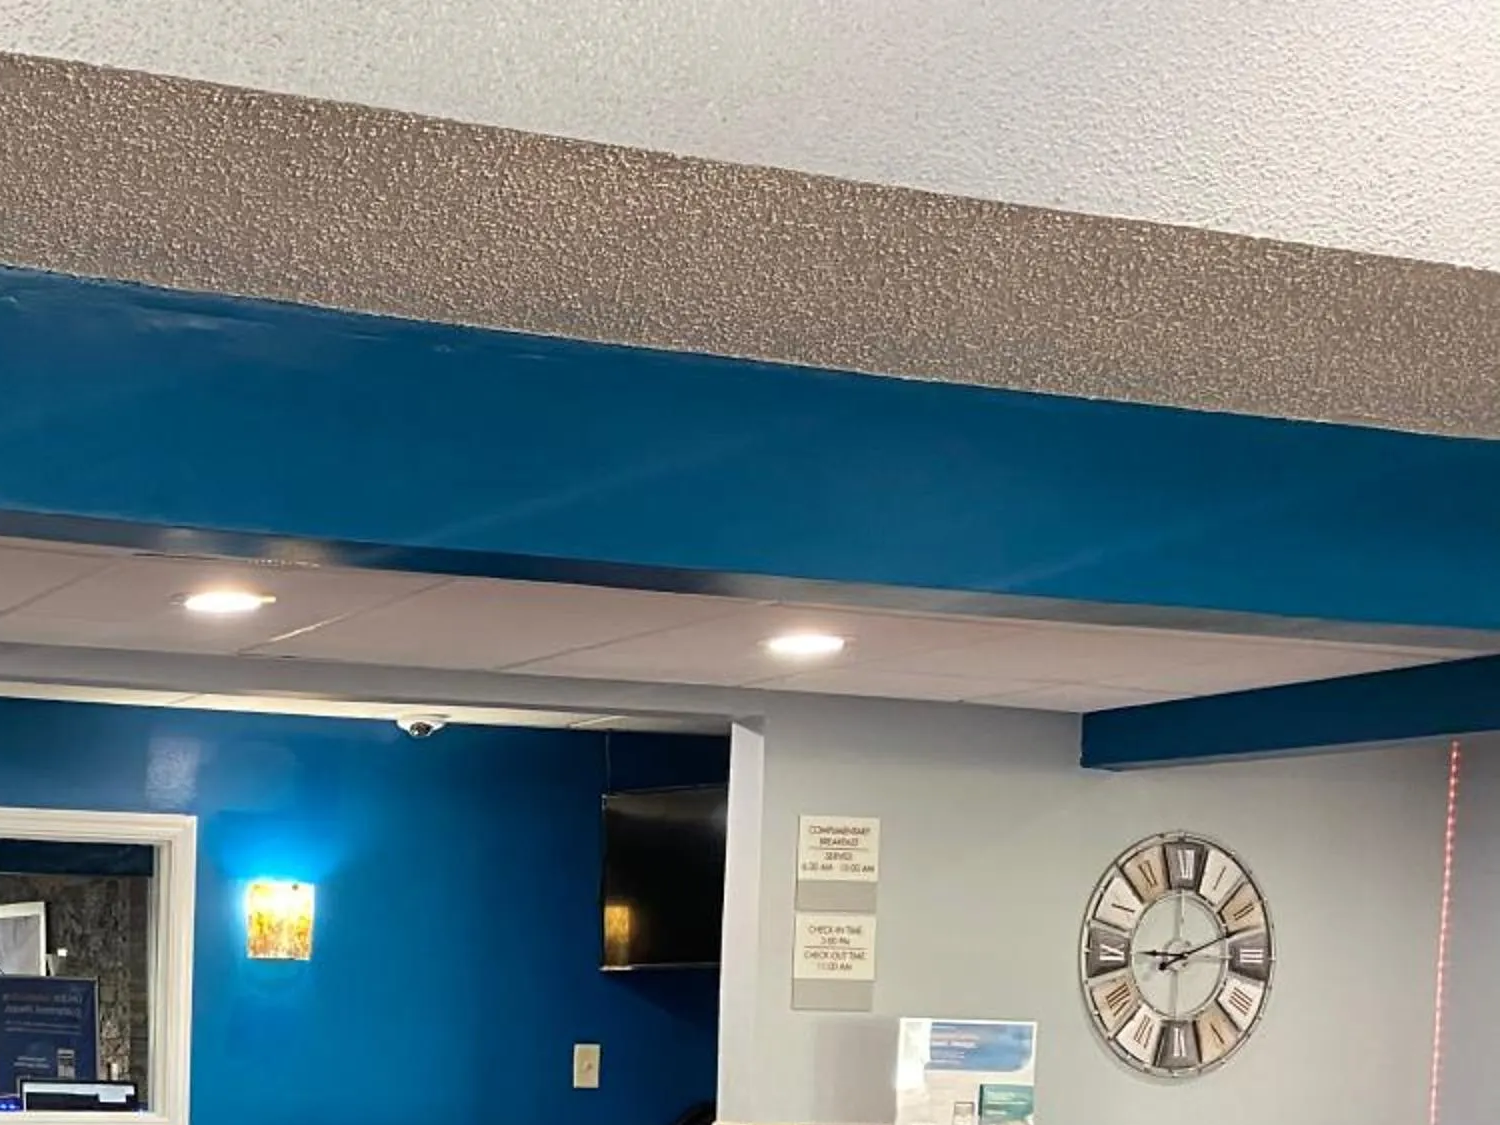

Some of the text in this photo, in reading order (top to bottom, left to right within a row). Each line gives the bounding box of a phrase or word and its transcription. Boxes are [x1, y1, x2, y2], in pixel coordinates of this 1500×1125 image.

[819, 837, 859, 847] BREAKFAST
[861, 865, 876, 873] AM
[847, 926, 863, 935] TIME
[848, 952, 866, 961] TIME
